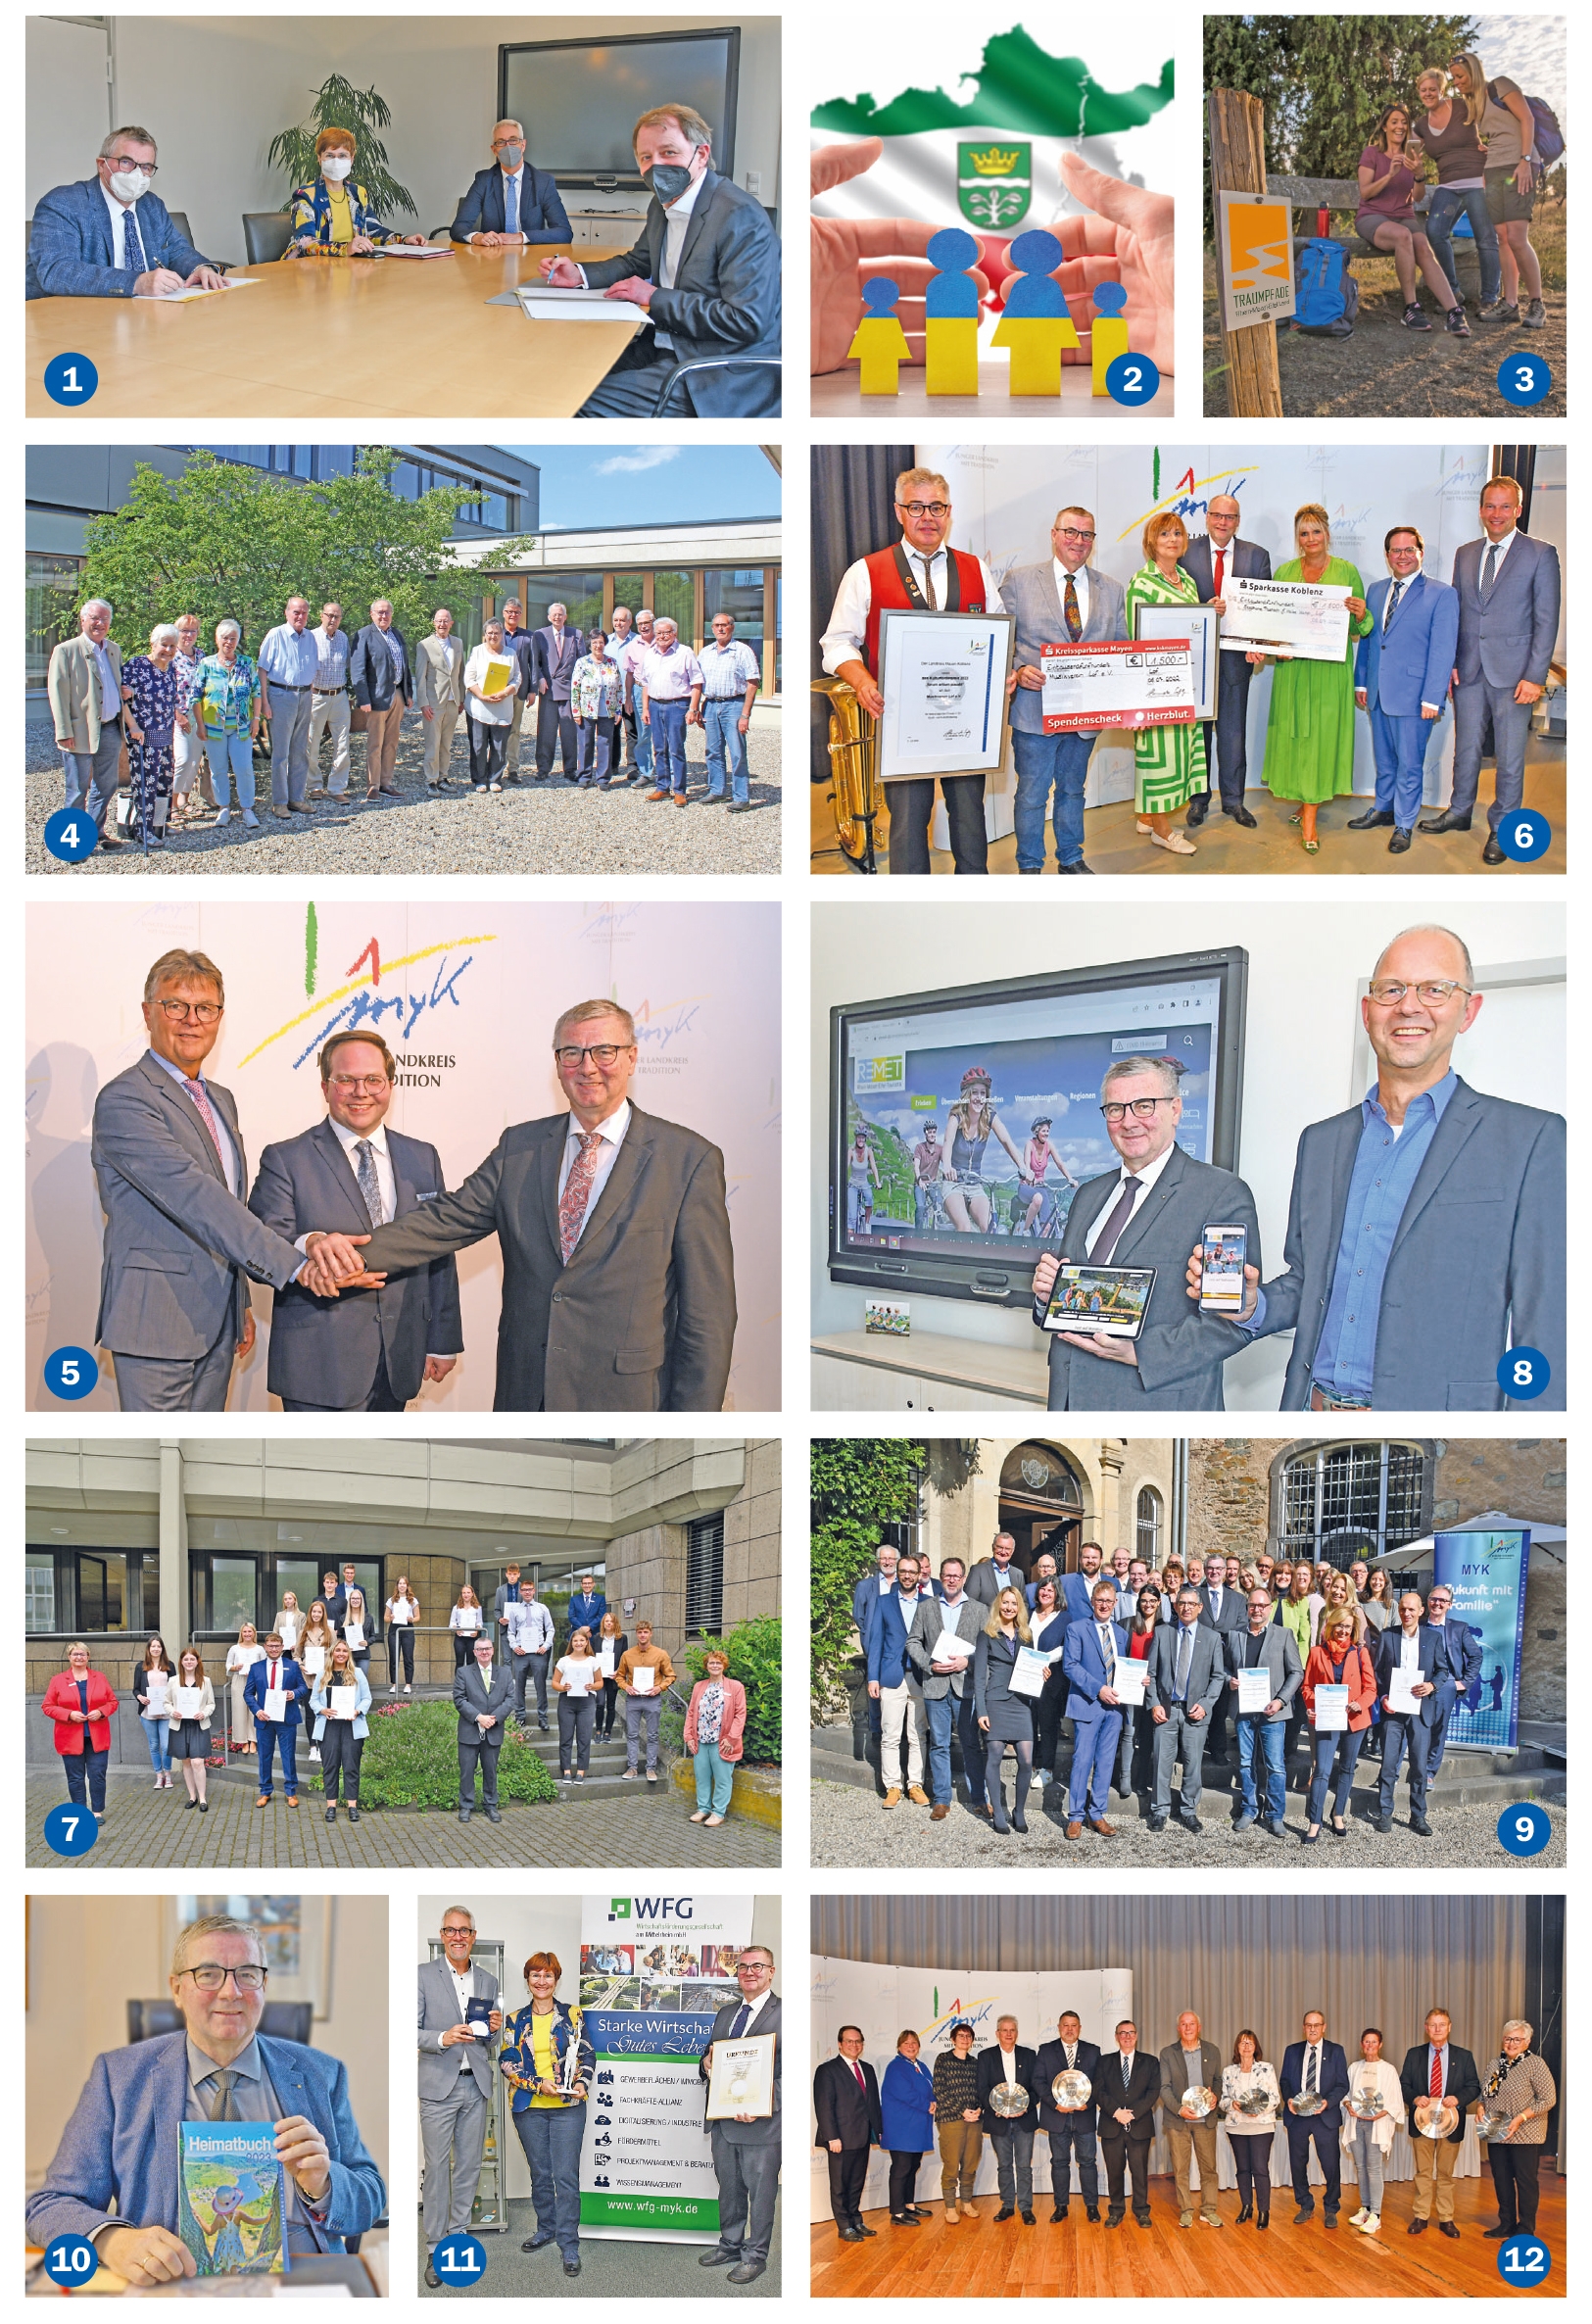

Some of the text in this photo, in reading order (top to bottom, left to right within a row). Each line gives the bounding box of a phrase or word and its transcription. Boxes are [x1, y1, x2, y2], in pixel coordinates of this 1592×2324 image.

[1233, 285, 1290, 308] TRAUMPFADE
[1249, 583, 1324, 596] Sparkasse Koblenz
[1055, 646, 1133, 655] Kreissparkasse Mayen
[1048, 714, 1122, 727] Spendenscheck
[395, 1054, 457, 1068] NDKREIS
[857, 1058, 902, 1082] REMET
[1069, 1091, 1096, 1101] Regionen
[1462, 1565, 1489, 1574] MYK
[1492, 1584, 1514, 1595] mit
[635, 1898, 694, 1919] WFG
[598, 2018, 715, 2035] Starke Wirtschaf
[606, 2035, 707, 2058] Gutes Lebe
[620, 2075, 675, 2085] GEWERBEFLÄCHEN
[619, 2096, 683, 2106] FACHKRÄFTE-ALLIANZ
[618, 2116, 666, 2126] DIGITALISIERUNG
[189, 2136, 272, 2153] Heimatbuch
[617, 2137, 662, 2147] FÖRDERMITTEL
[245, 2153, 272, 2163] 2023
[616, 2157, 683, 2167] PROJEKTMANAGEMENT
[606, 2201, 699, 2214] www.wfg-myk.de
